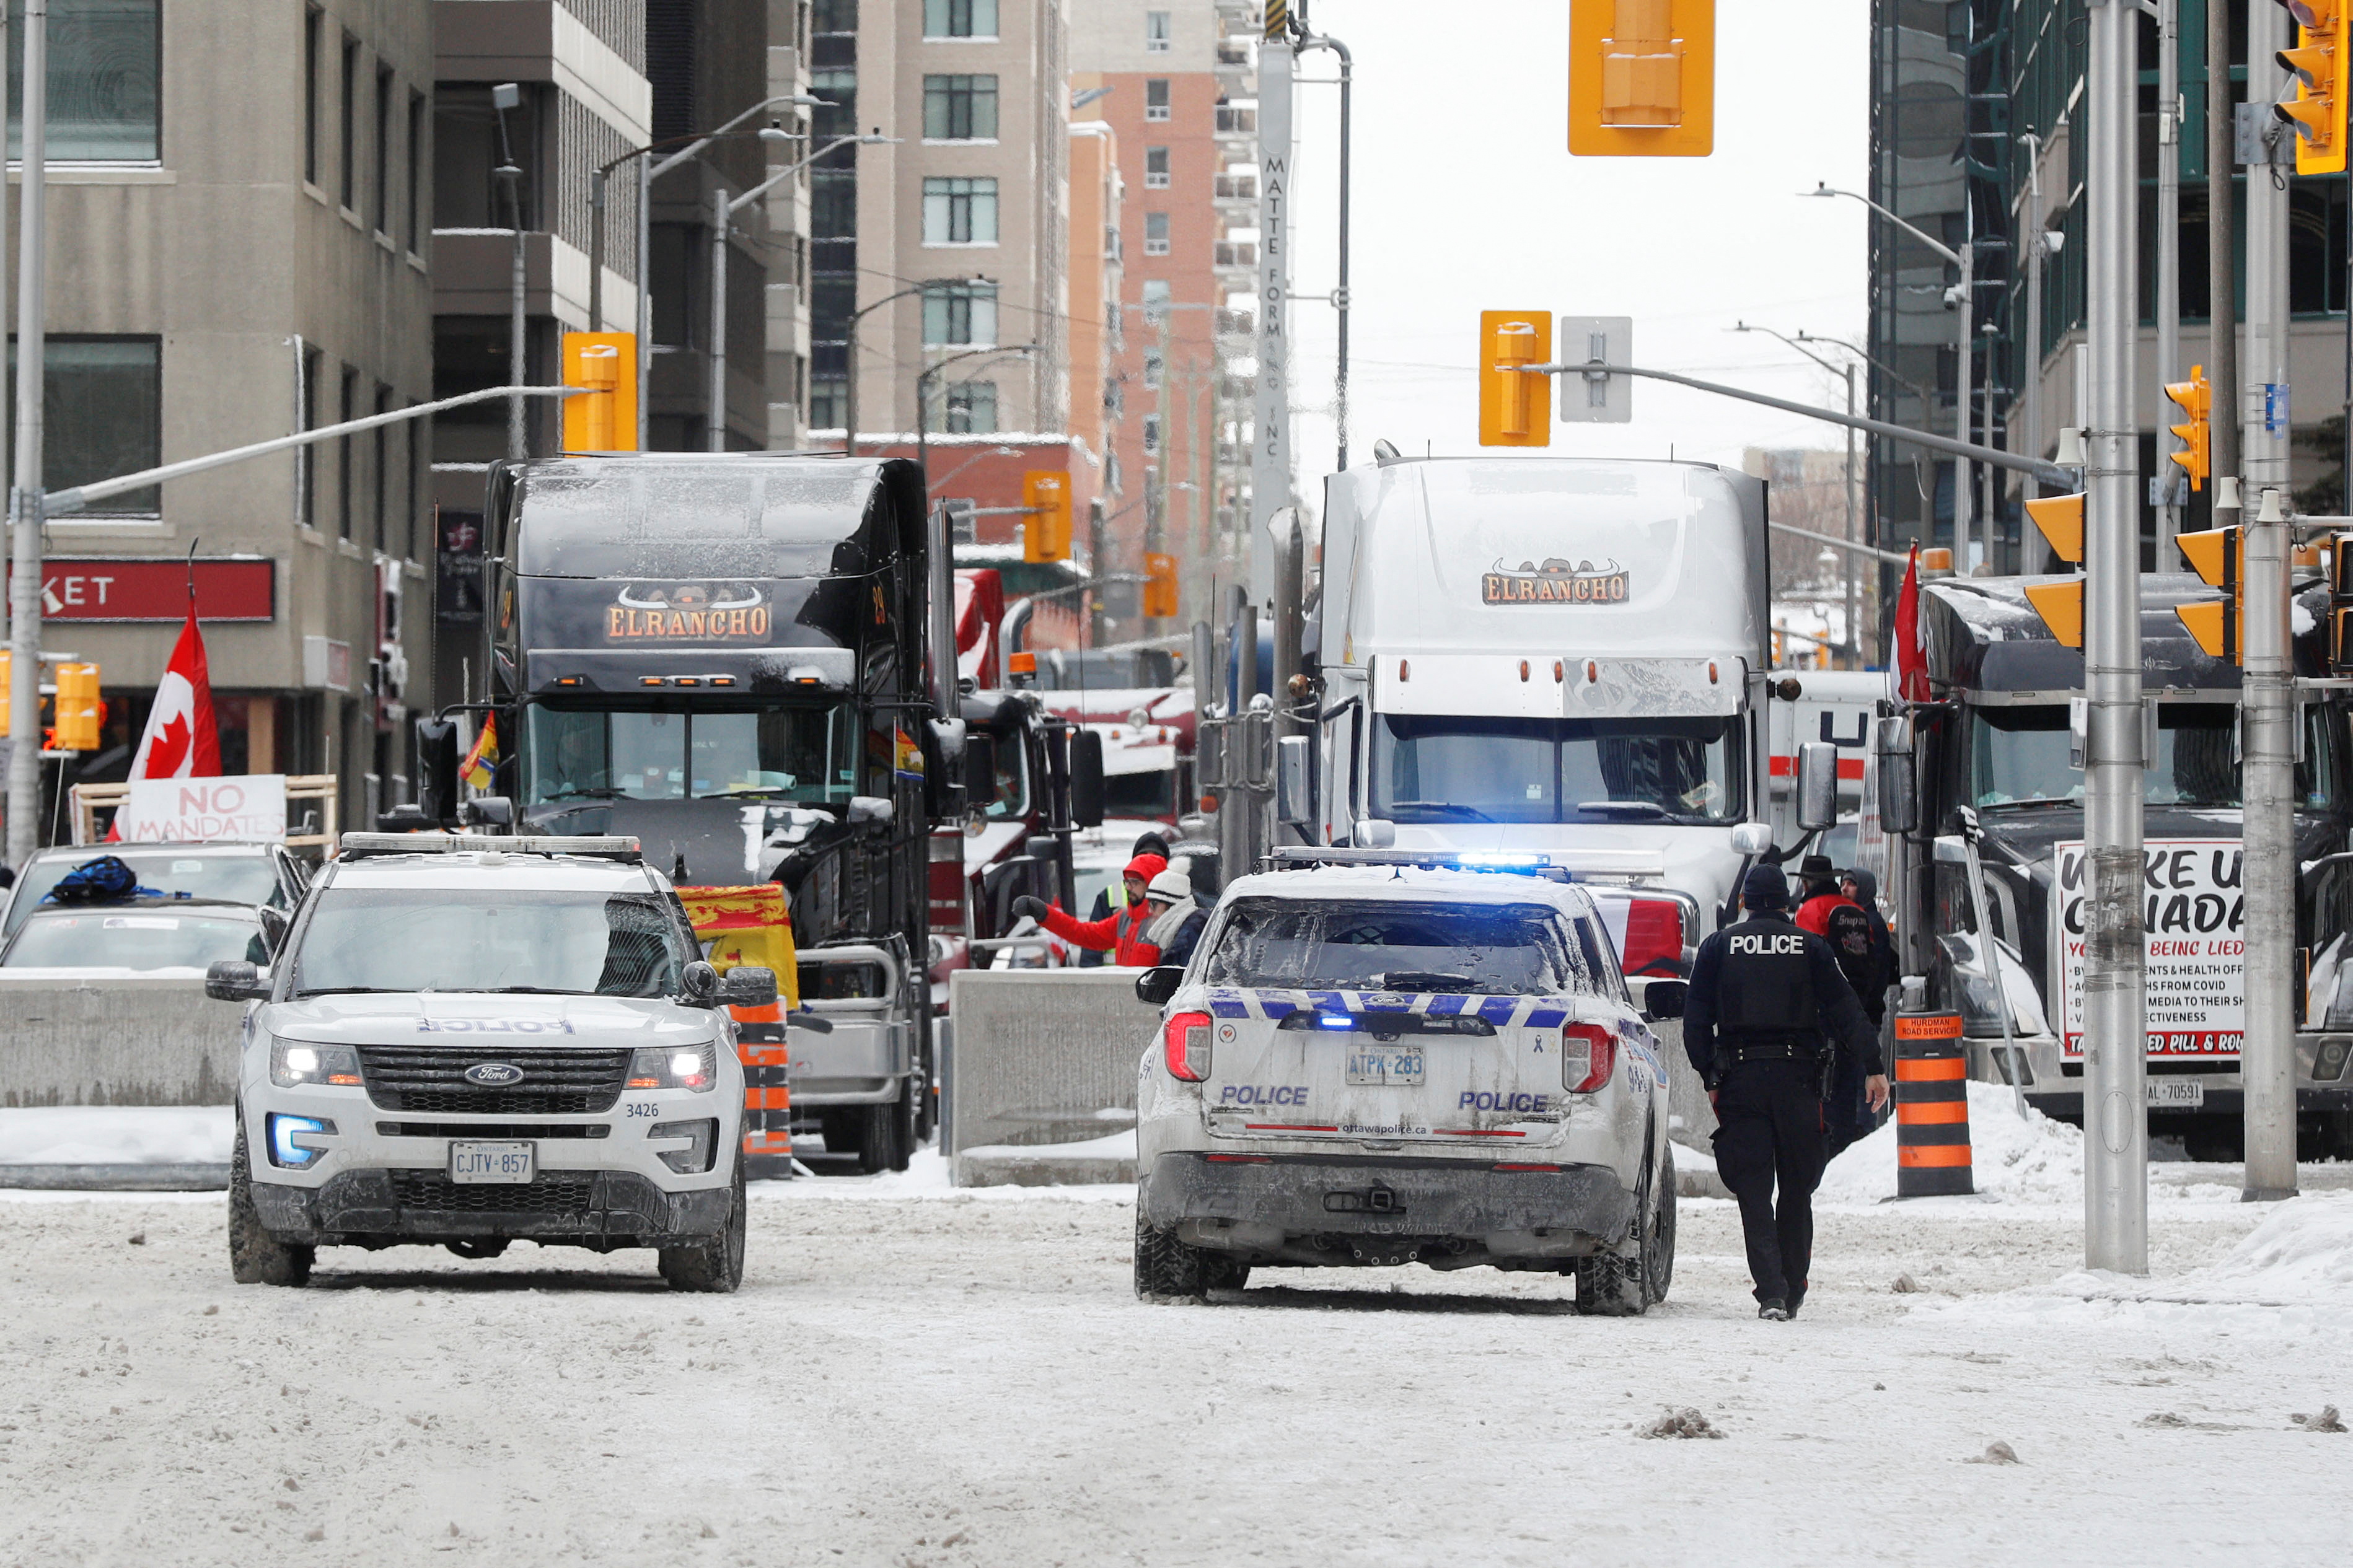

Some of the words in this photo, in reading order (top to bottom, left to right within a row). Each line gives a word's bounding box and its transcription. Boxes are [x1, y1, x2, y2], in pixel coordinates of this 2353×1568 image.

[1265, 157, 1285, 255] MATTE
[1487, 575, 1625, 601] ELRANCHO
[873, 585, 886, 625] 29
[609, 607, 767, 637] ELRANCHO
[180, 784, 245, 817] NO
[136, 813, 286, 842] MANDATES
[2061, 850, 2198, 891] WKE
[2064, 893, 2243, 935] CNAD
[1730, 935, 1804, 955] POLICE
[2150, 940, 2200, 957] BEING
[2179, 965, 2220, 975] HEALTH
[2161, 981, 2191, 991] FROM
[2194, 980, 2225, 991] COVID
[2148, 997, 2182, 1007] MEDIA
[2184, 996, 2197, 1006] TO
[2200, 996, 2230, 1006] THEIR
[1924, 1027, 1958, 1035] SERVICES
[2170, 1033, 2199, 1052] PILL
[2203, 1033, 2214, 1051] &
[478, 1067, 510, 1080] Ford
[1394, 1055, 1422, 1074] 283
[1220, 1085, 1309, 1105] POLICE
[2168, 1085, 2200, 1099] 70591
[627, 1103, 659, 1118] 3426
[1459, 1092, 1548, 1113] POLICE
[1342, 1124, 1427, 1134] ottawapolice.ca
[457, 1154, 491, 1172] CJTV
[502, 1154, 529, 1173] 857
